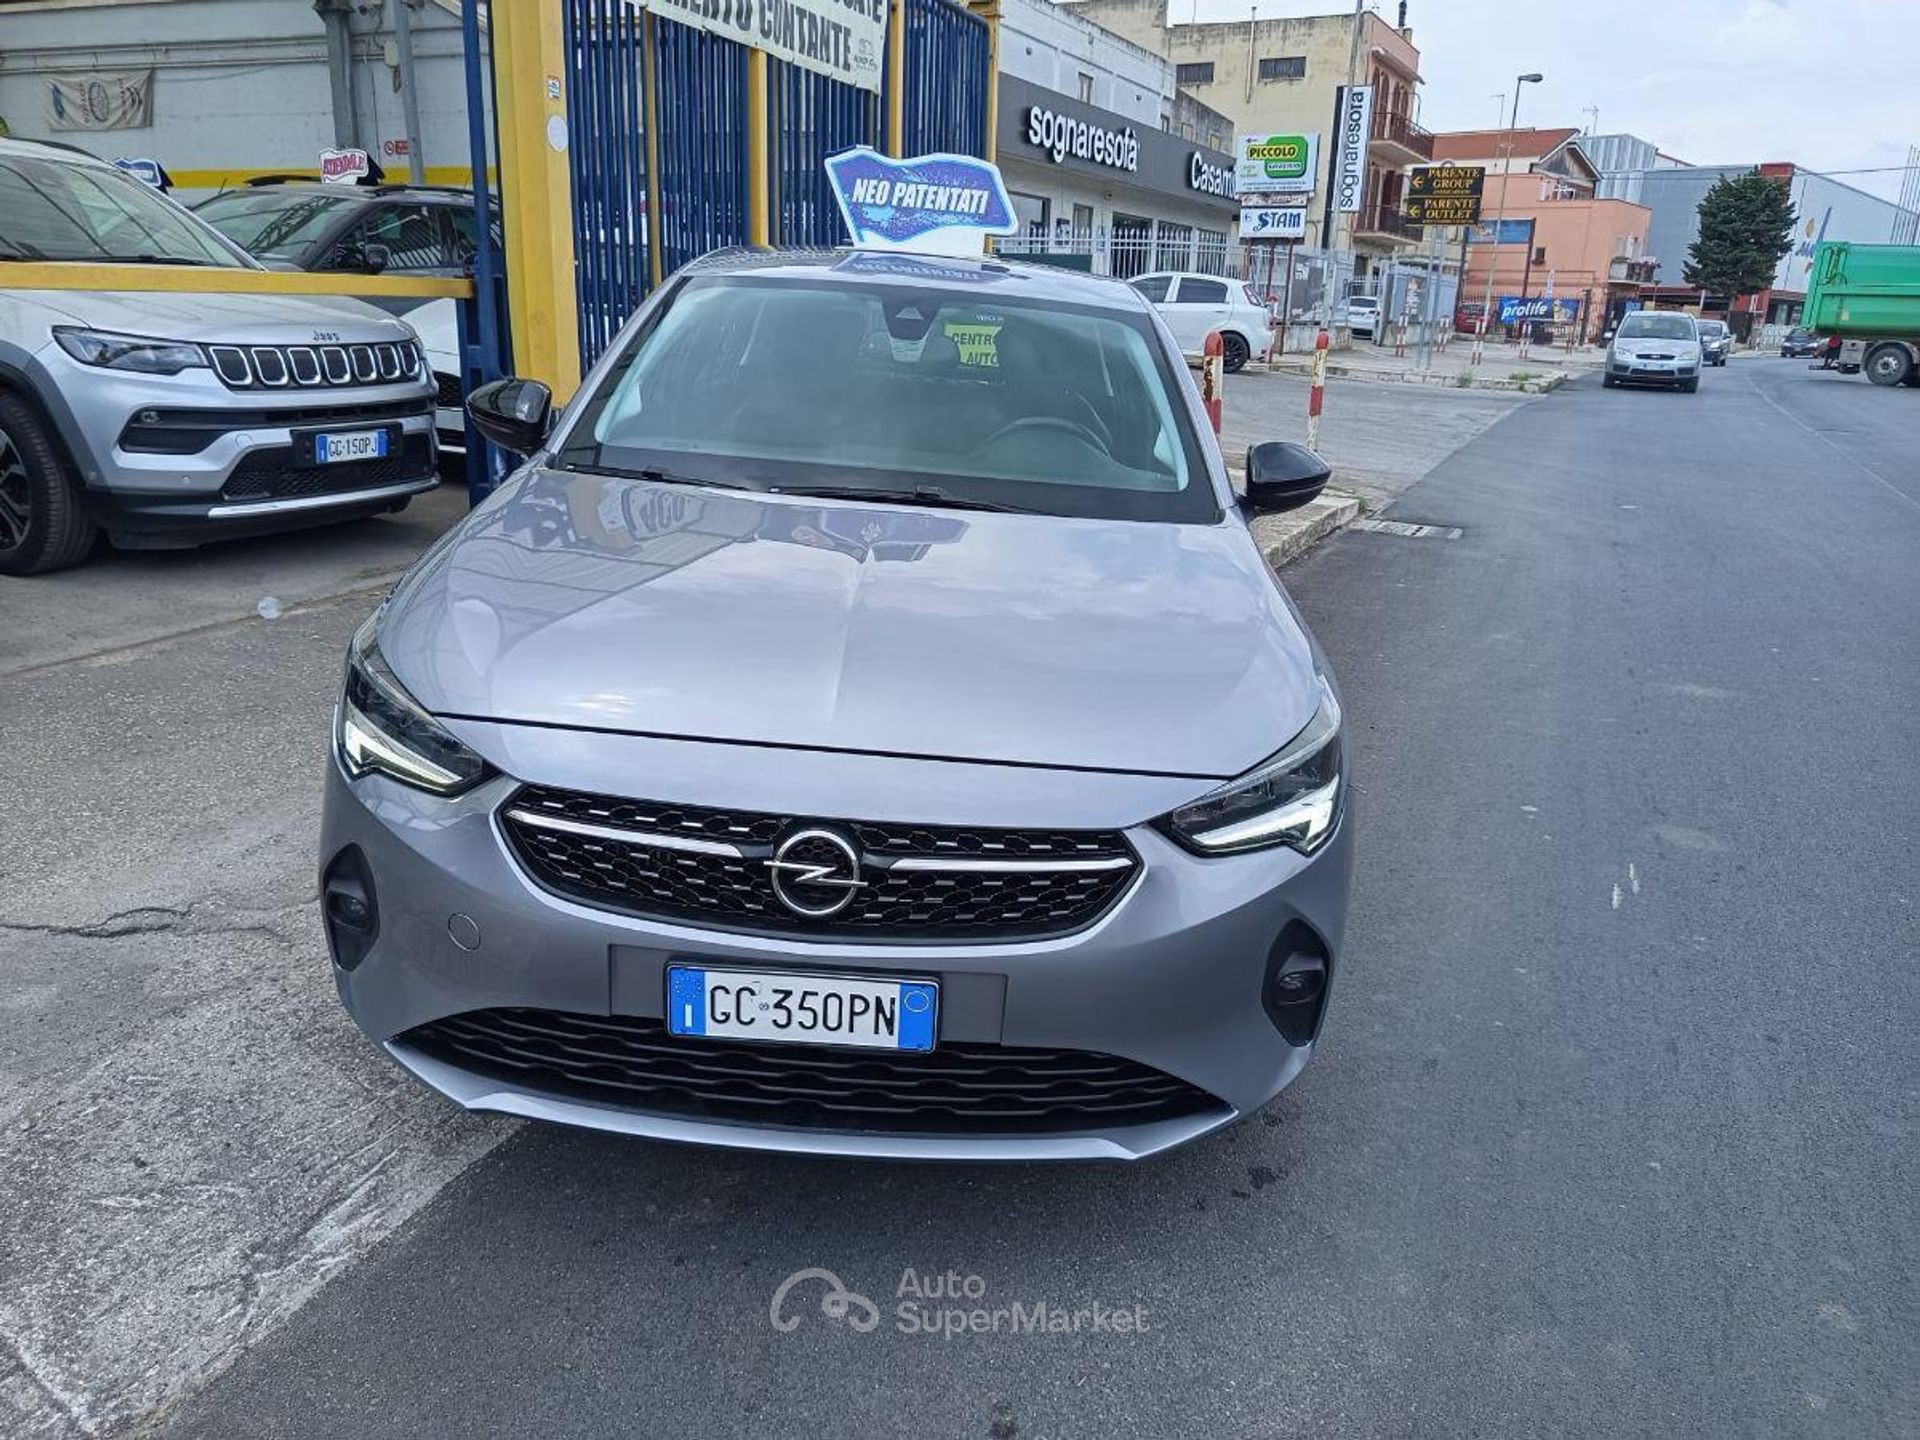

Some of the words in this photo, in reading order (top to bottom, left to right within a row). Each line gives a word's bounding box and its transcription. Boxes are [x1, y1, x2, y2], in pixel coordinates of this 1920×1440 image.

[759, 0, 851, 72] CONTANTE
[1029, 105, 1138, 173] sognaresofà
[1249, 146, 1297, 158] PICCOLO
[1428, 168, 1480, 178] PARENTE
[1432, 178, 1474, 189] GROUP
[852, 178, 890, 205] NEO
[892, 181, 991, 215] PATENTATI
[1423, 198, 1477, 209] PARENTE
[1425, 209, 1472, 219] OUTLET
[1252, 211, 1302, 232] STAM
[1501, 300, 1548, 321] prolife
[966, 351, 998, 365] AUTO
